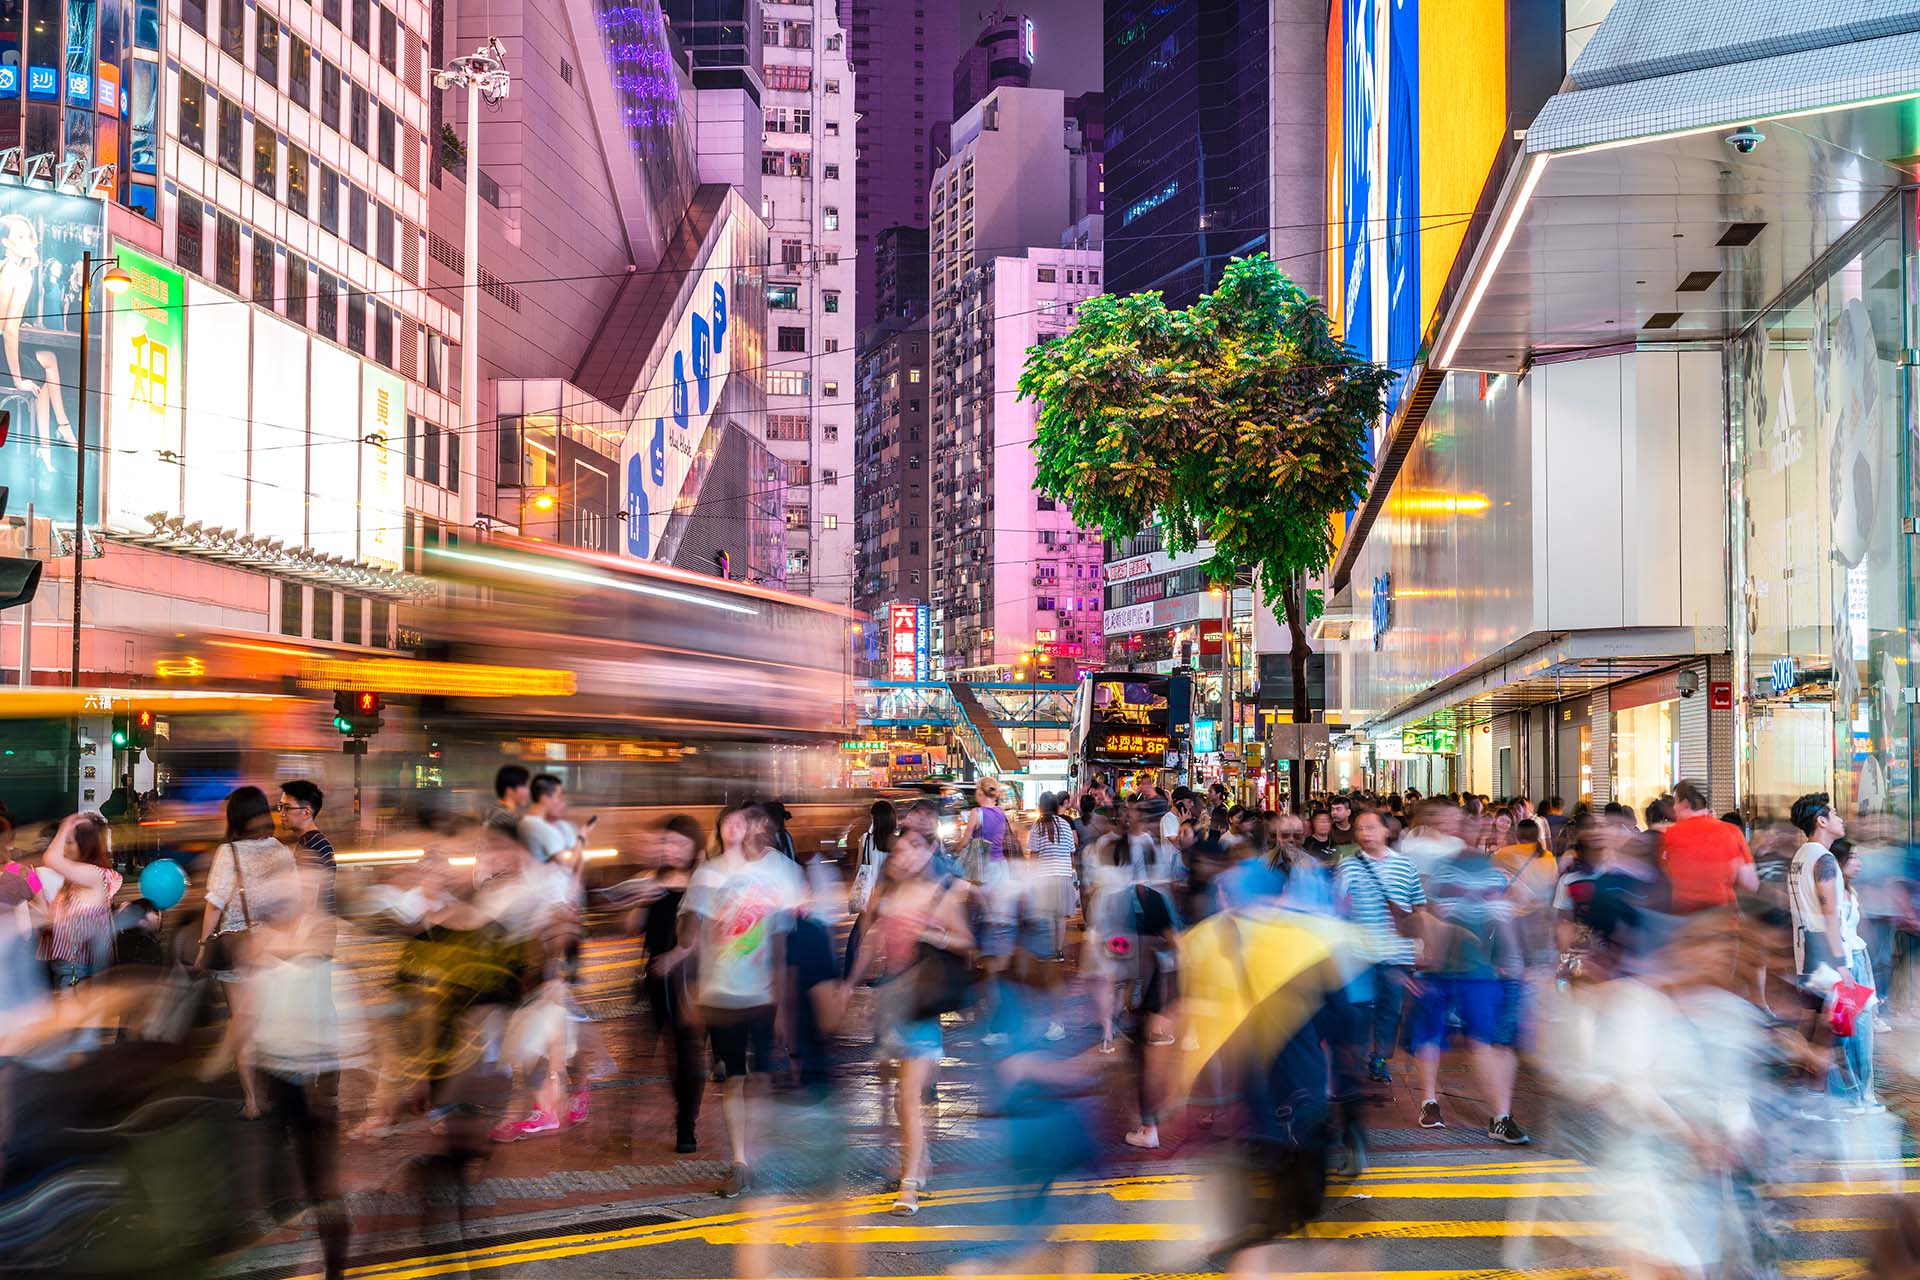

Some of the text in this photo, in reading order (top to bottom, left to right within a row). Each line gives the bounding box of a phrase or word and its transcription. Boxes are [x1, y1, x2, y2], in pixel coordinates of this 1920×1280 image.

[582, 508, 601, 553] GAP
[1771, 656, 1794, 692] SOGO
[1108, 735, 1143, 746] 小西灣
[1130, 744, 1143, 752] Wan
[1146, 741, 1165, 753] 8P
